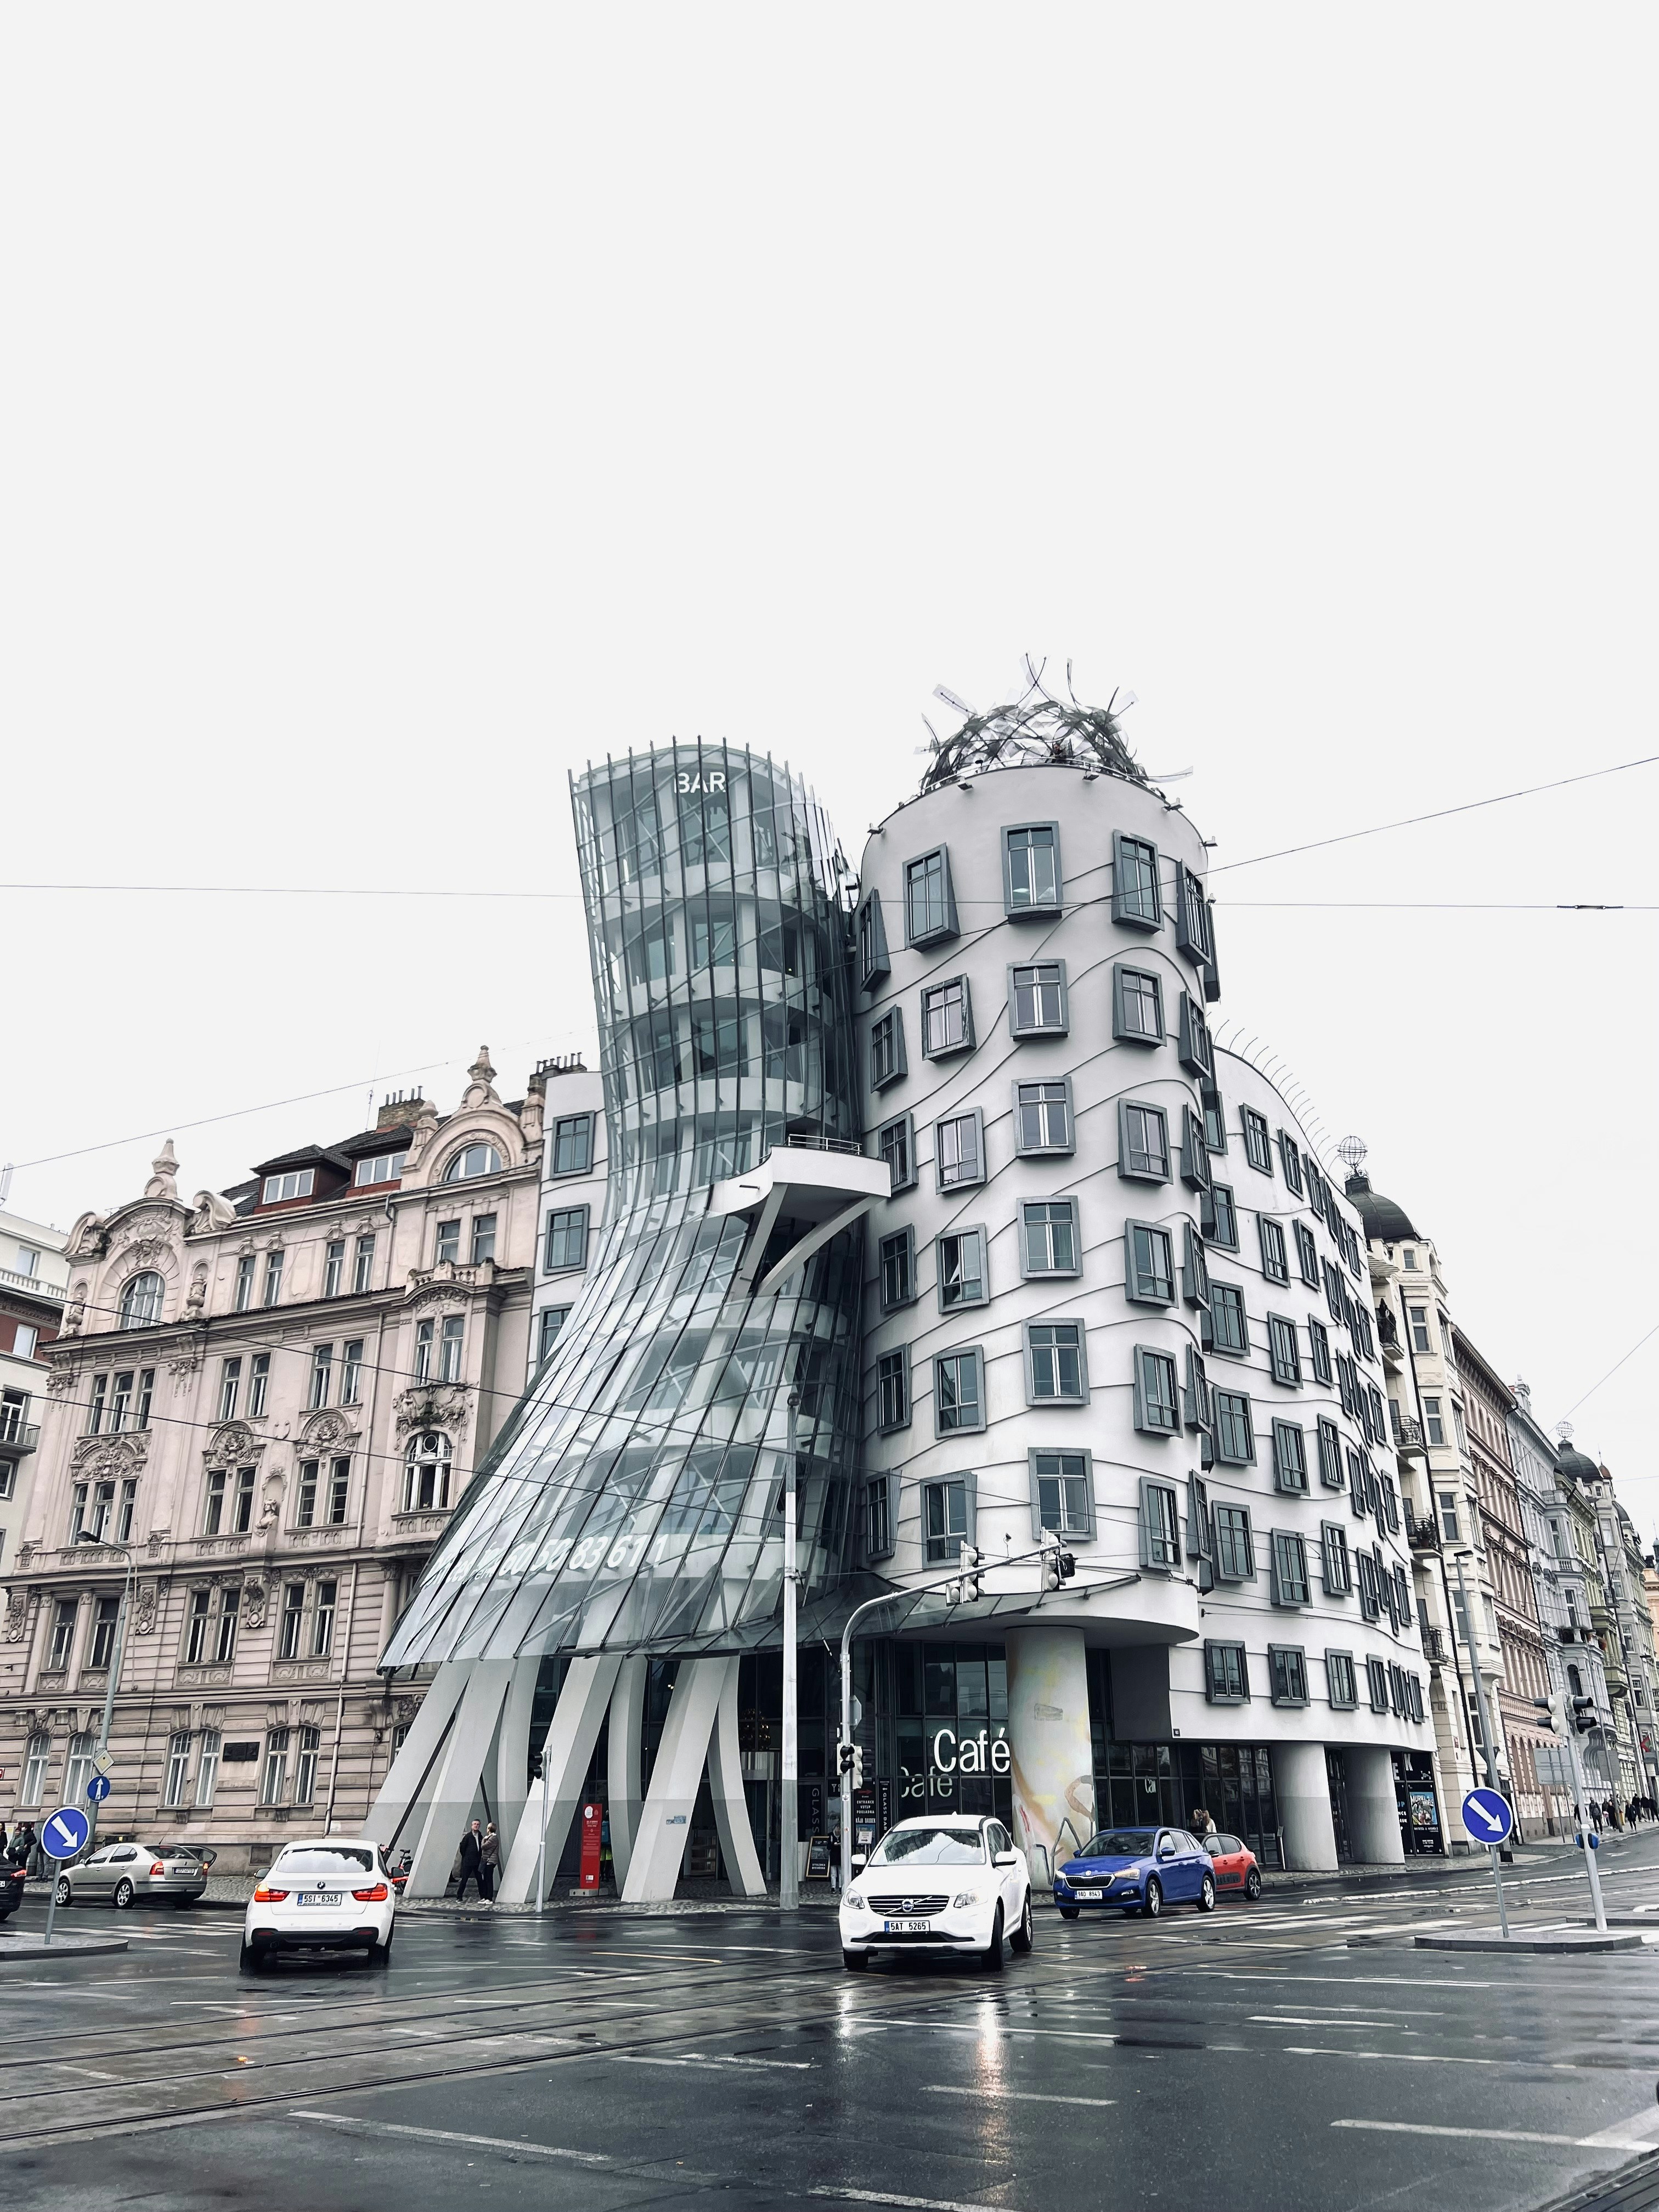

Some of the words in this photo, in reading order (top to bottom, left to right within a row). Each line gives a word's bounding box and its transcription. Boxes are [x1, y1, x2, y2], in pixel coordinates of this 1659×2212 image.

[674, 771, 726, 793] BAR
[934, 1727, 1011, 1773] Café
[811, 1788, 820, 1833] GLASS
[890, 1922, 904, 1931] 5AT
[909, 1922, 926, 1930] 5265
